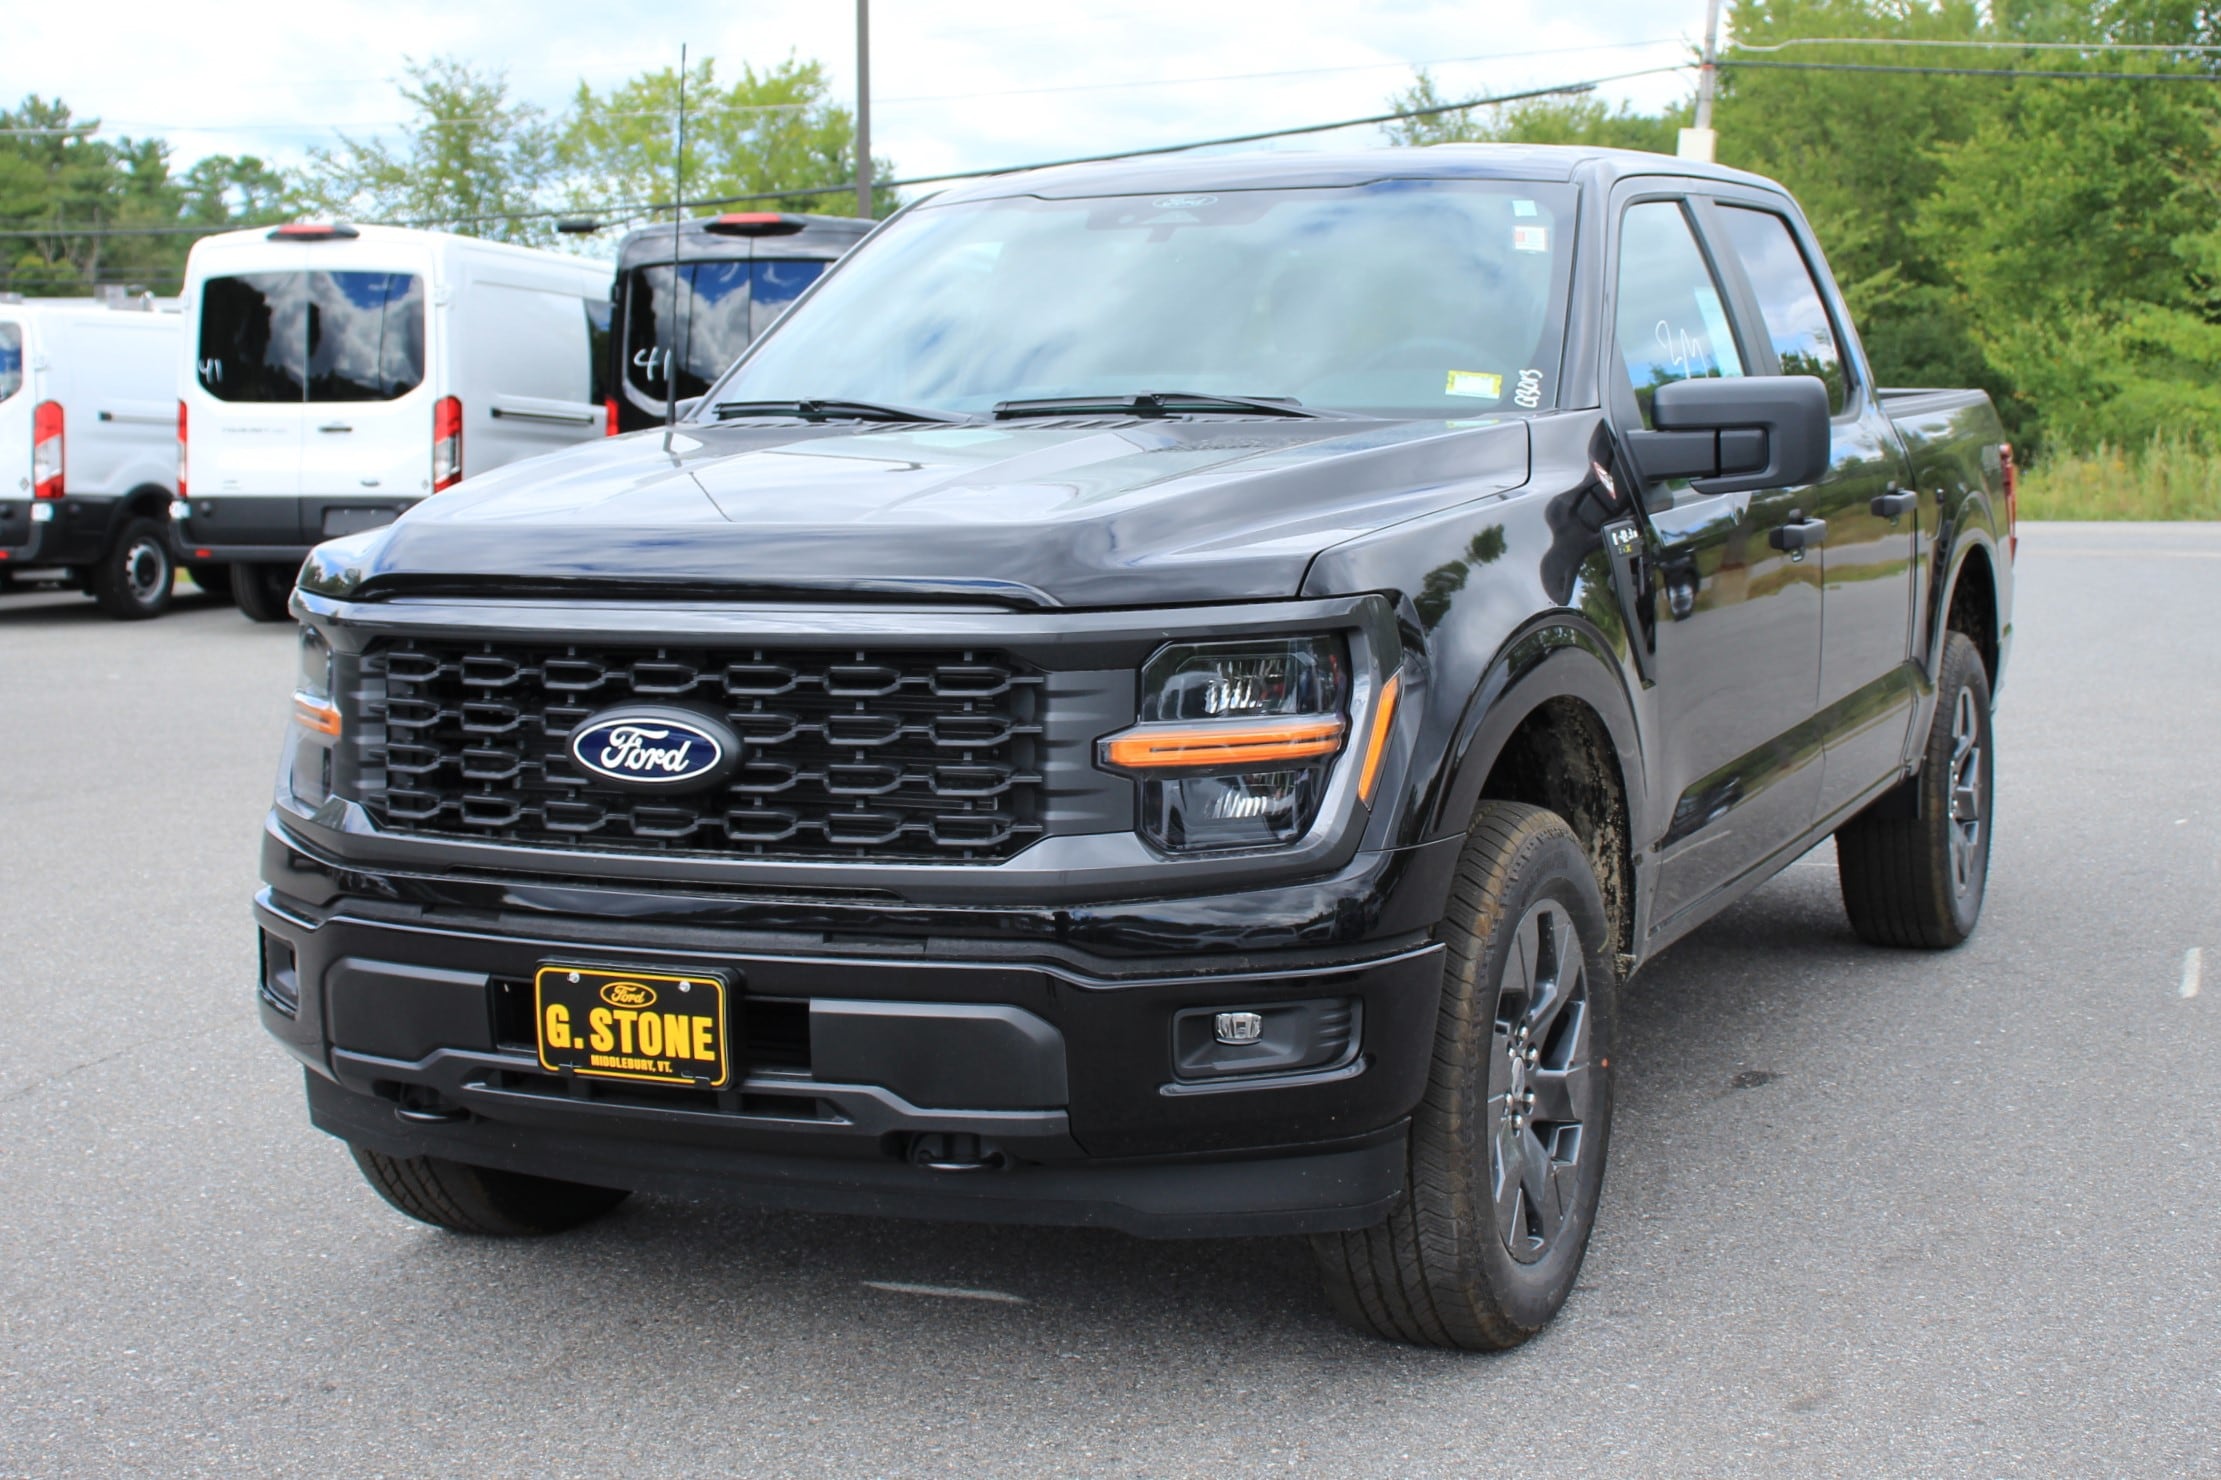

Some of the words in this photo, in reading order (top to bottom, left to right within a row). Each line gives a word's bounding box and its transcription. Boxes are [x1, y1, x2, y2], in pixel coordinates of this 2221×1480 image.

[199, 358, 223, 384] 41
[633, 346, 672, 381] 41
[600, 726, 692, 772] Ford
[610, 984, 646, 1005] Ford
[545, 1003, 585, 1050] G.
[588, 1007, 716, 1061] STONE
